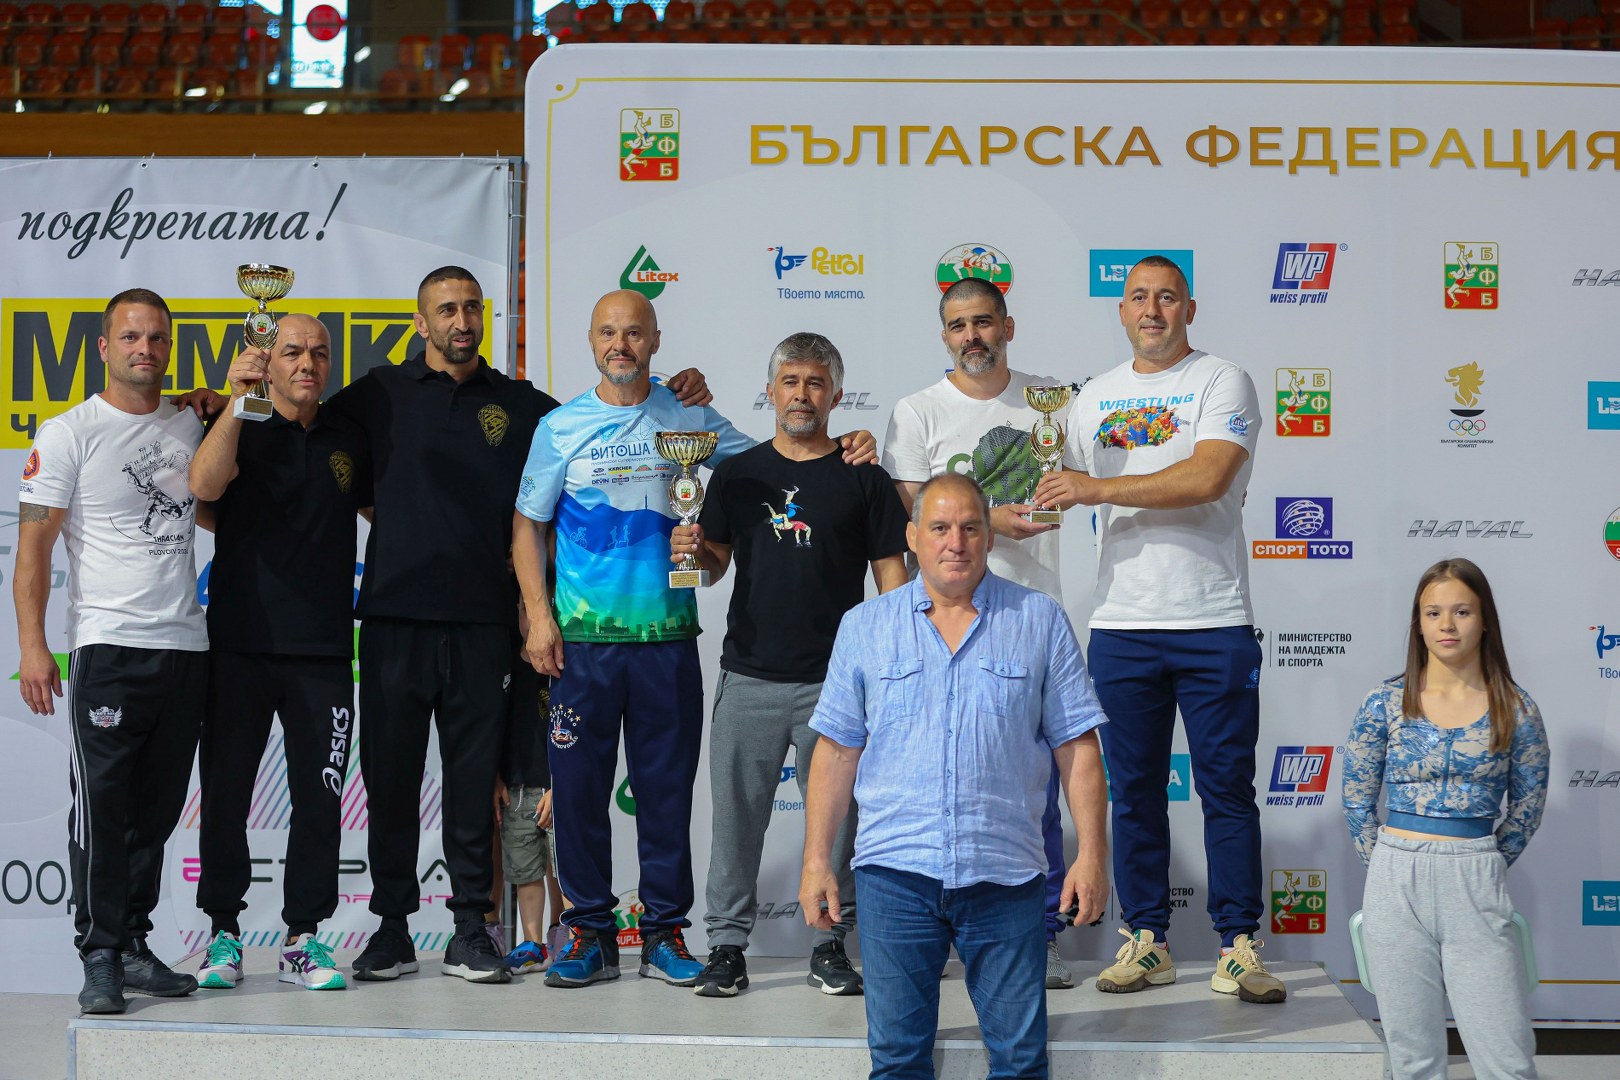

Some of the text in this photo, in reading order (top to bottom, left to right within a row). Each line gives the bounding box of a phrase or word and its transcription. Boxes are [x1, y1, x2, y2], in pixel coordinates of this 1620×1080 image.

[750, 125, 1620, 177] БЪЛГАРСКА ФЕДЕРАЦИЯ
[17, 182, 348, 260] подкрепата!
[1284, 253, 1326, 280] WP
[1270, 291, 1328, 306] weiss profil
[1099, 393, 1195, 411] WRESTLING
[591, 443, 651, 461] ВИТОША
[1407, 520, 1533, 538] HAVAL
[1255, 545, 1349, 555] СПОРТ ТОТО
[1278, 633, 1352, 642] МИНИСТЕРСТВО
[1278, 646, 1346, 656] НА МЛАДЕЖТА
[1278, 658, 1323, 667] И СПОРТА
[329, 706, 350, 768] asics
[1280, 756, 1322, 783] WP
[1266, 795, 1325, 809] weiss profil
